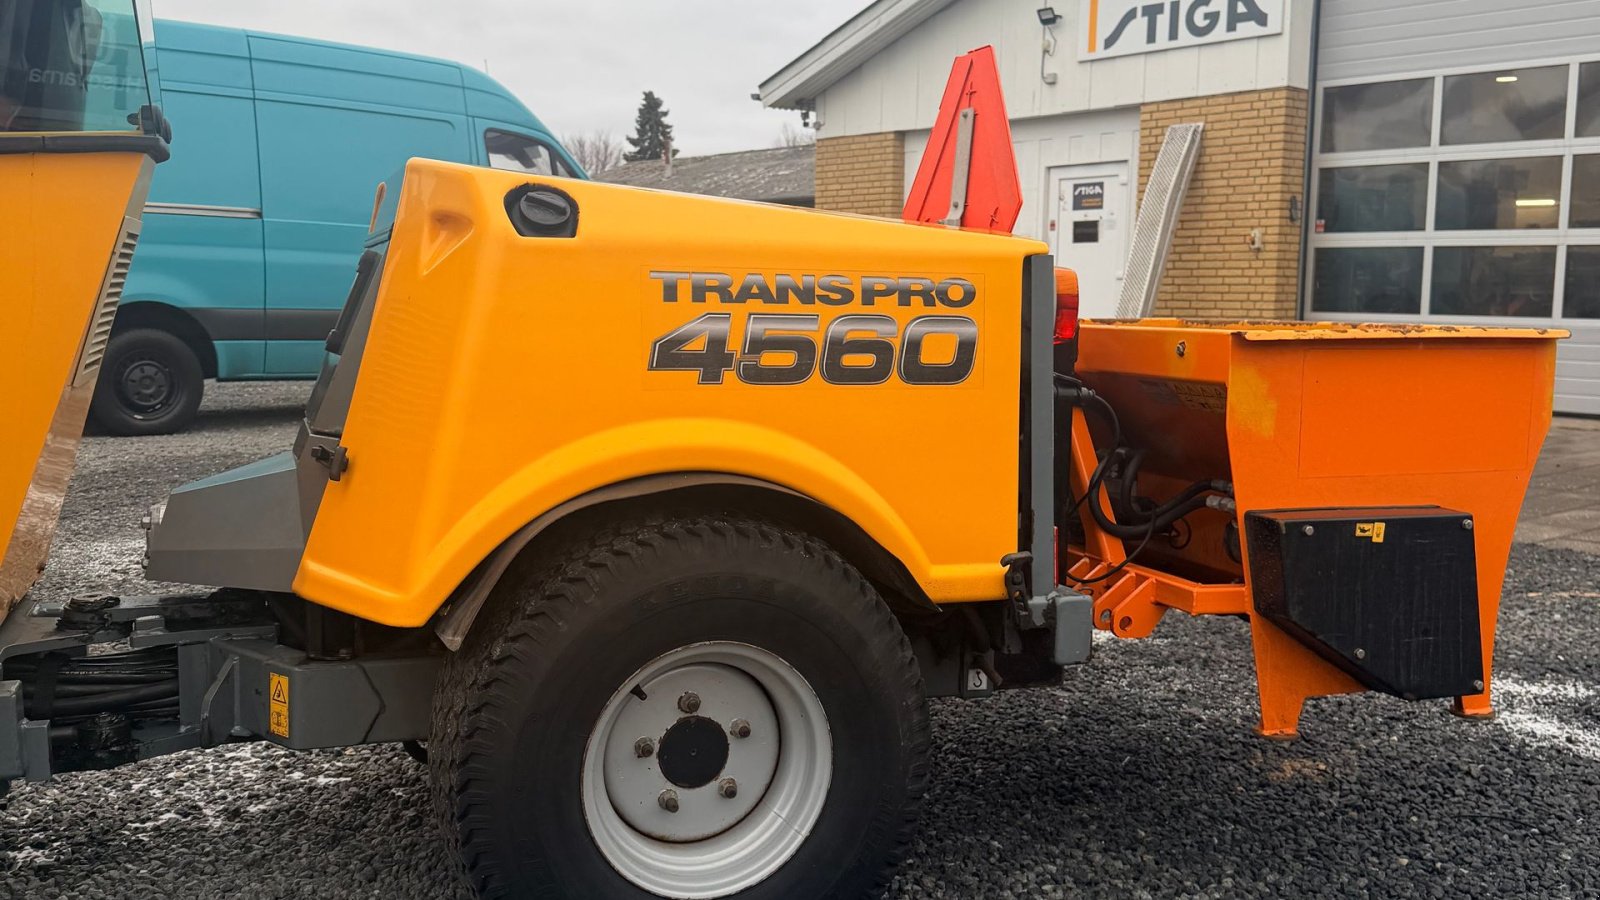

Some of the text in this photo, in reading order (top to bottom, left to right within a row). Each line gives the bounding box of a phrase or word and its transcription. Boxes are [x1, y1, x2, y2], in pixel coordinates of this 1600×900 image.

[1103, 0, 1268, 50] STIGA
[1074, 185, 1103, 196] STIGA
[650, 271, 976, 307] TRANS PRO
[647, 312, 979, 386] 4560
